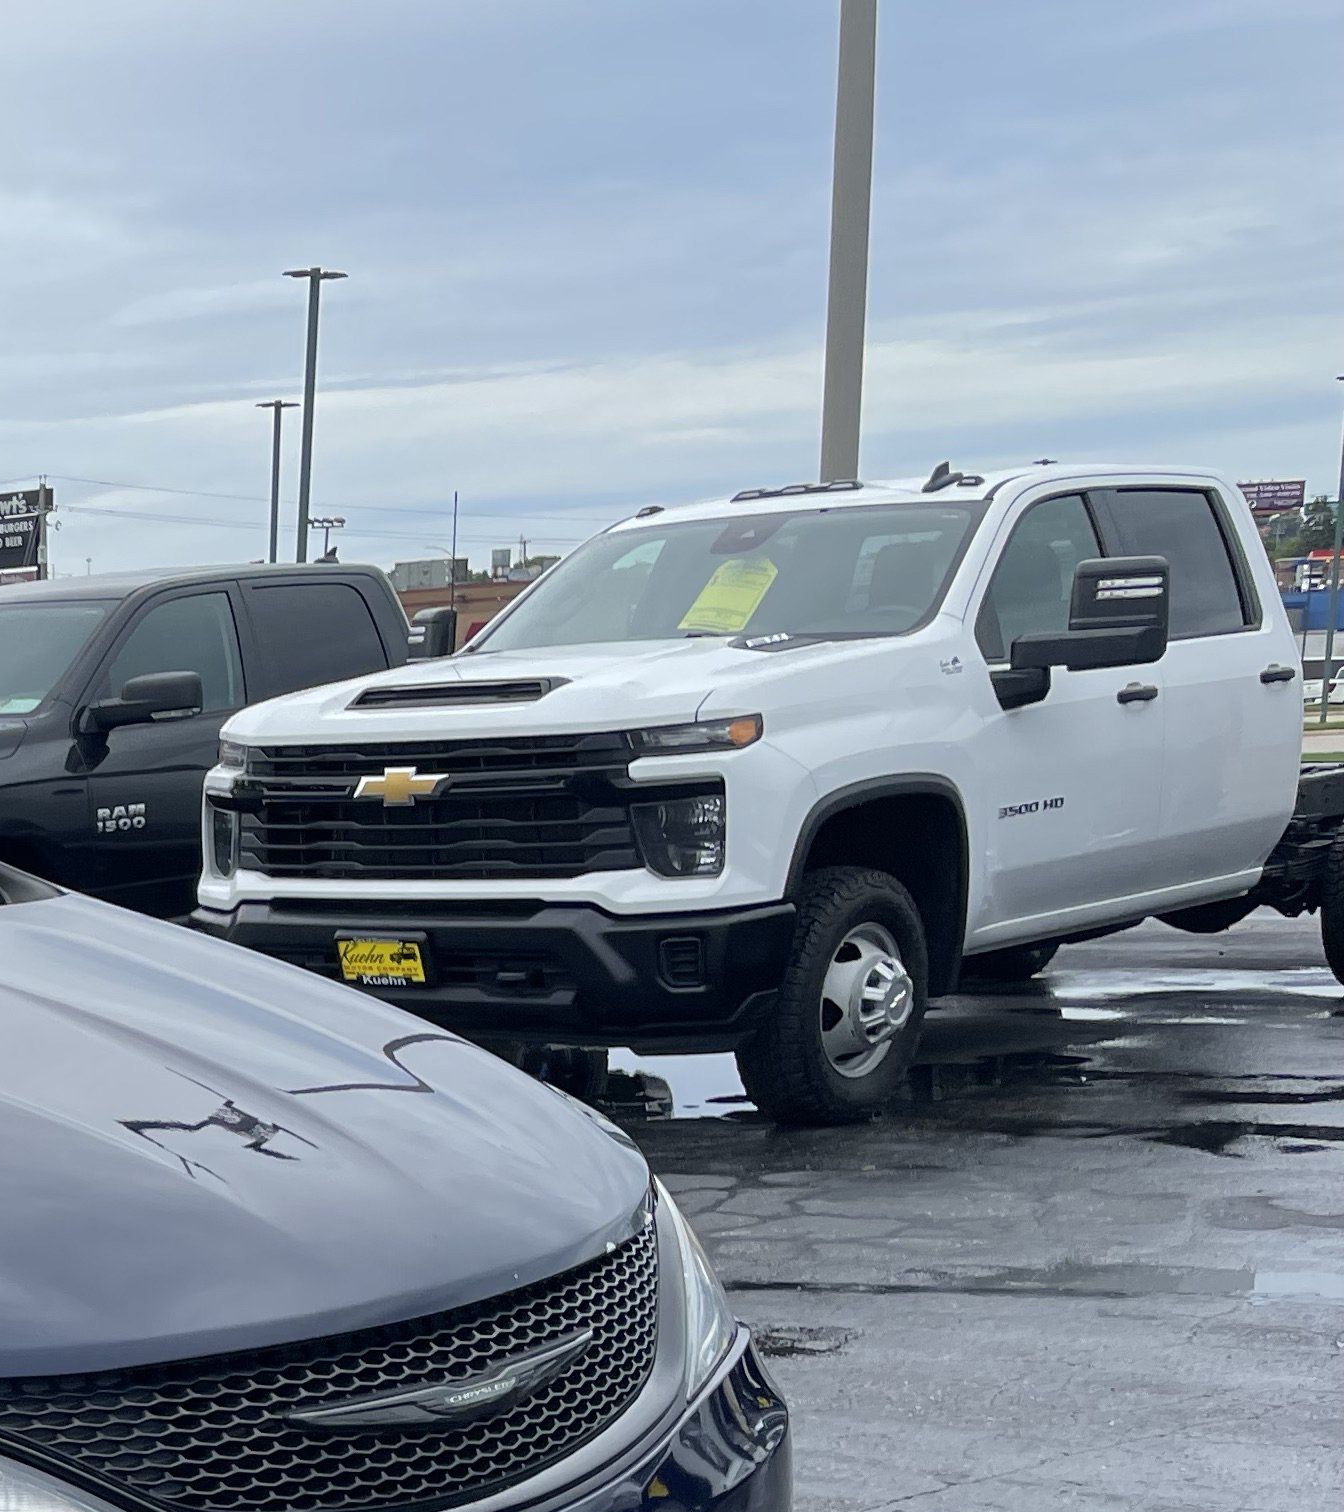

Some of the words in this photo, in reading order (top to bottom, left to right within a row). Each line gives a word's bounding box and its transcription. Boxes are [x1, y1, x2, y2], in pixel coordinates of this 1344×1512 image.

[0, 521, 34, 534] BURGERS
[5, 536, 23, 548] BEER
[97, 803, 145, 820] RAM
[998, 801, 1039, 819] 3500
[1043, 797, 1064, 811] HD
[97, 816, 146, 833] 1500
[340, 941, 384, 965] Kuehn
[361, 974, 407, 986] Kuehn
